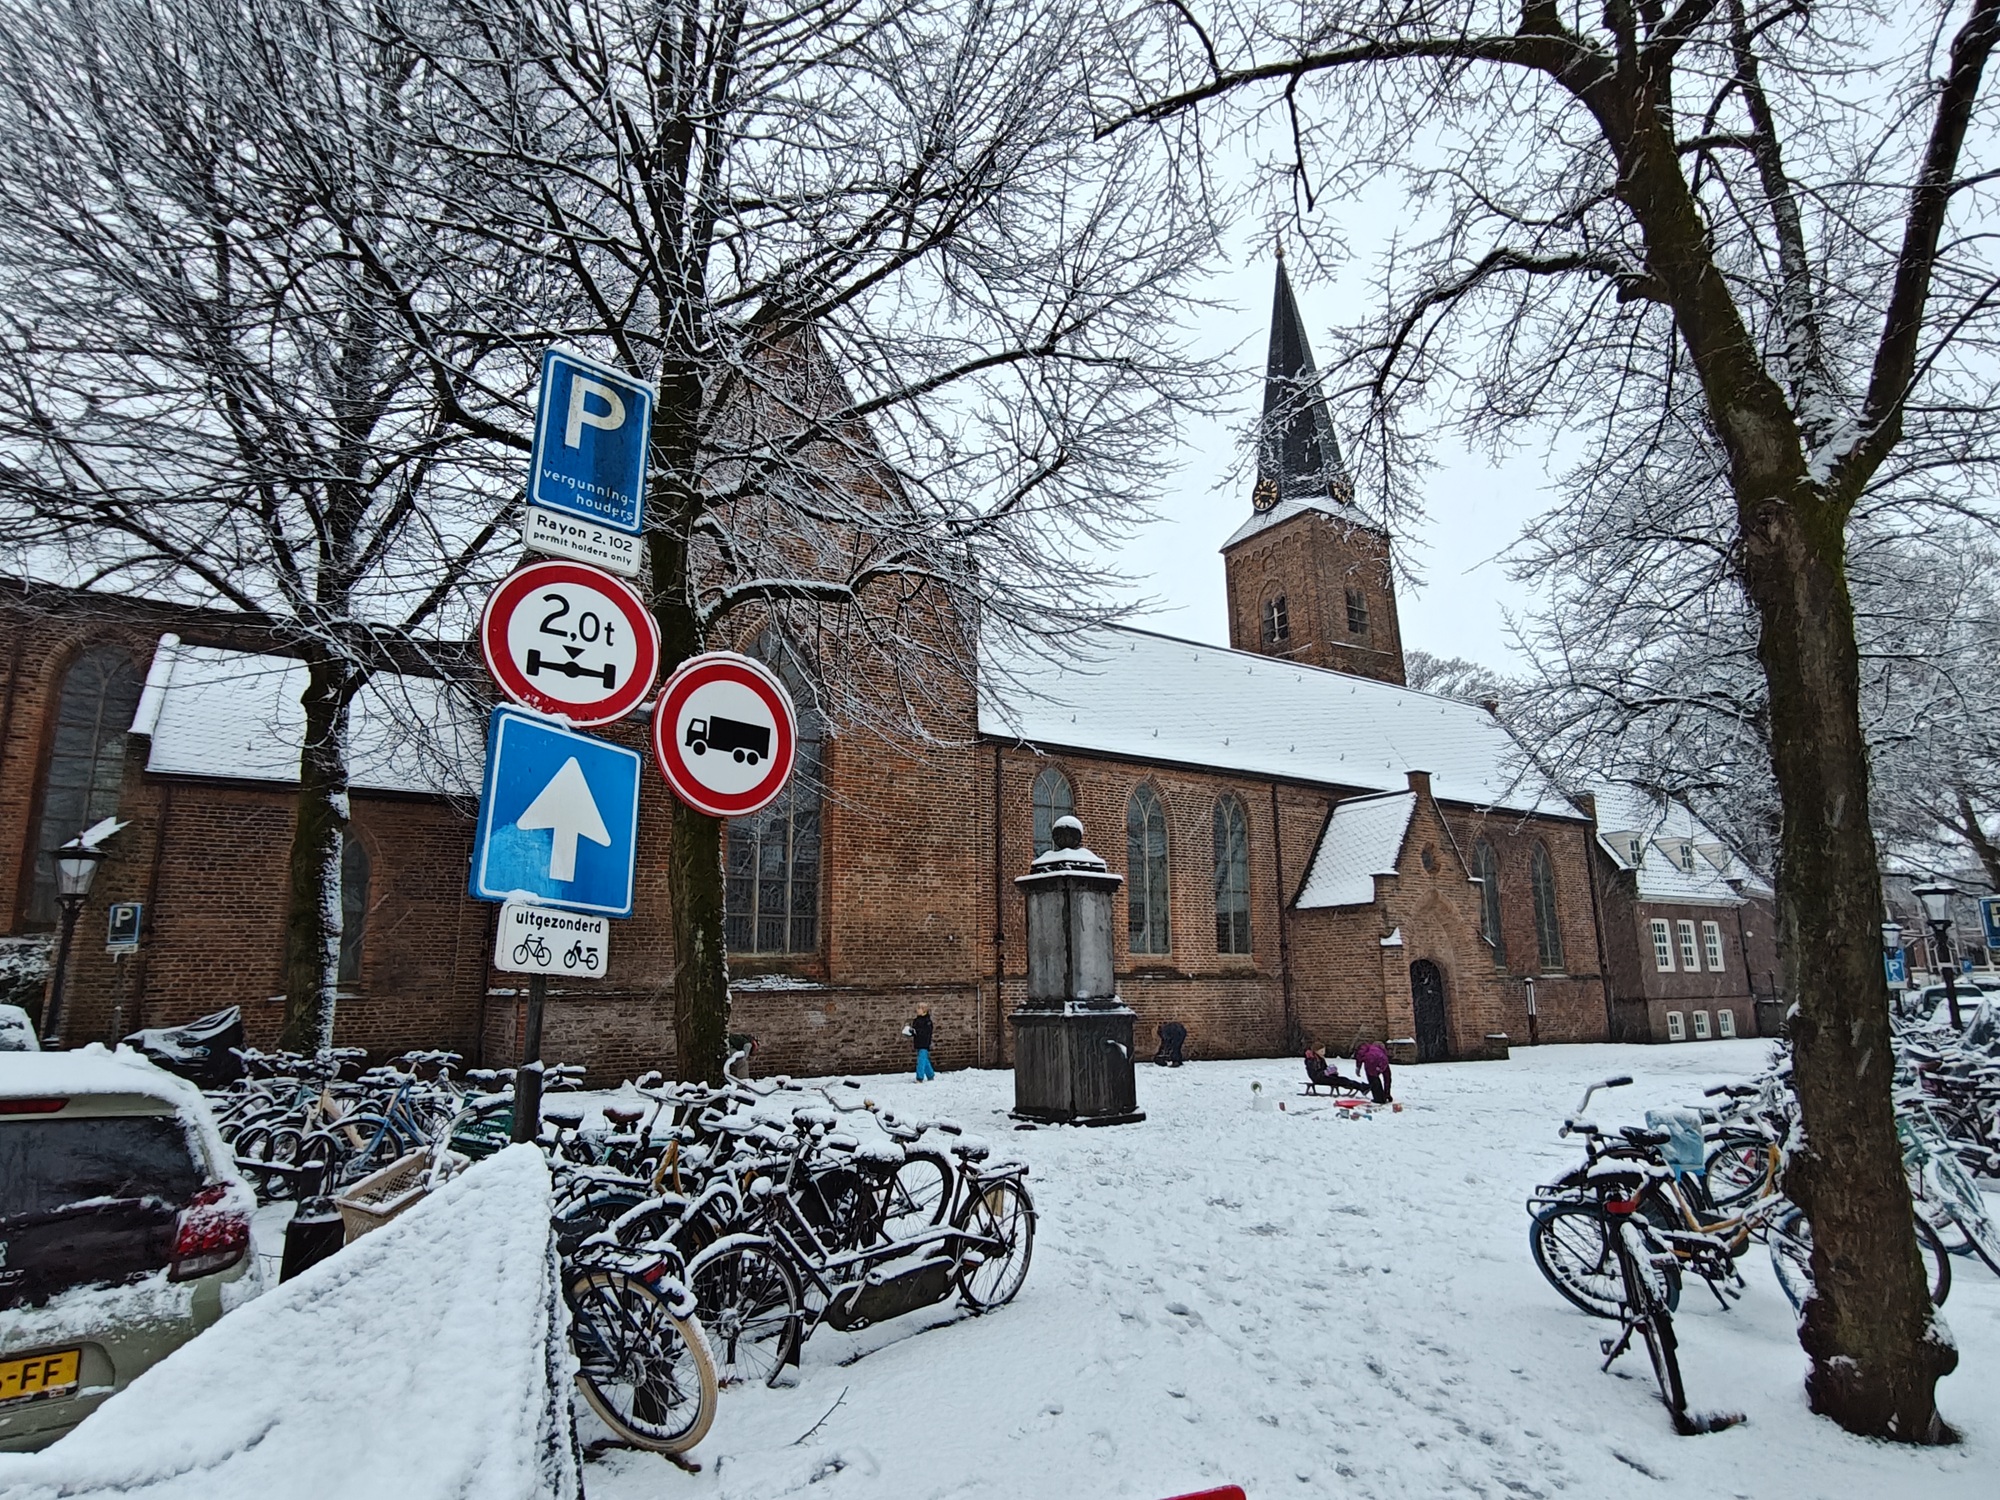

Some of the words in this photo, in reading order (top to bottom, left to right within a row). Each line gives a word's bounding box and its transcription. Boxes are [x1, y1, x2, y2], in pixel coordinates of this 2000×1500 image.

[564, 372, 626, 449] P
[543, 468, 635, 506] vergunning-
[576, 493, 634, 521] houders
[533, 531, 569, 547] permit
[571, 541, 608, 558] holders
[610, 553, 632, 566] only
[537, 514, 587, 539] Rayon
[592, 531, 633, 553] 2.102
[115, 907, 133, 928] P
[516, 910, 602, 934] uitgezonderd
[1888, 961, 1900, 974] P
